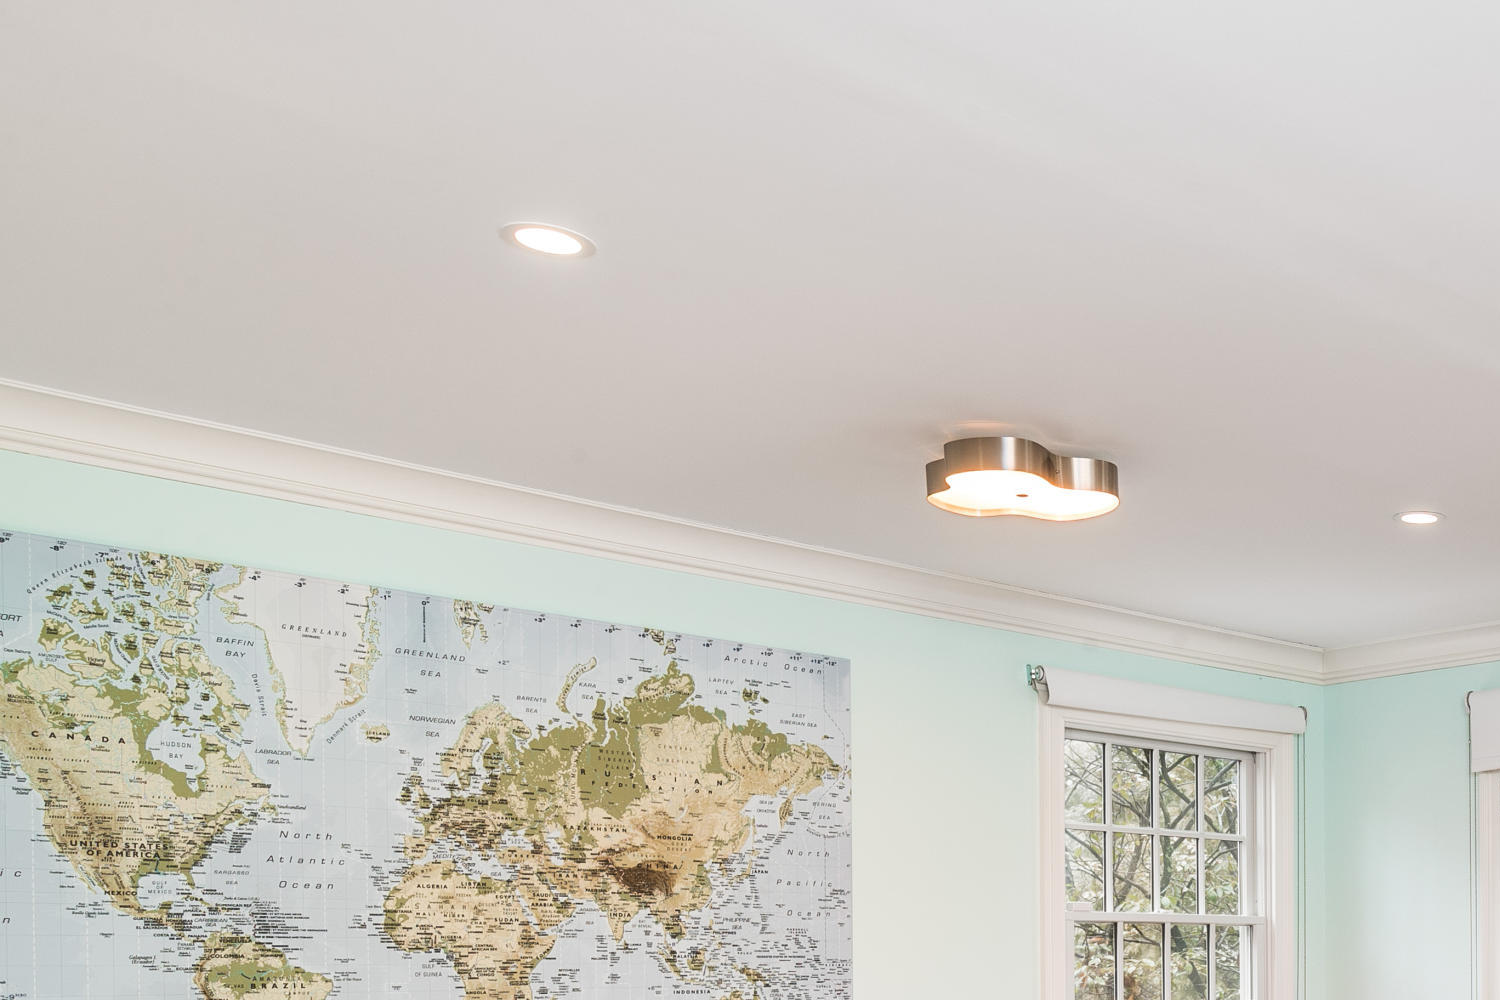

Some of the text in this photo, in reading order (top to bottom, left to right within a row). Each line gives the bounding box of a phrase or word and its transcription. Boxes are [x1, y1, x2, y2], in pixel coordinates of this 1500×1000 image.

[26, 577, 49, 595] Queen
[281, 623, 348, 639] GREENLAND
[216, 636, 255, 648] BAFFIN
[225, 650, 247, 659] BAY
[394, 647, 466, 663] GREENLAND
[723, 655, 823, 676] Arctic Ocean
[419, 669, 442, 679] SEA
[251, 673, 268, 718] Davis Strait
[516, 695, 547, 704] BARENTS
[525, 707, 539, 715] SEA
[408, 714, 457, 726] NORWEGIAN
[31, 730, 126, 745] CANADA
[425, 730, 441, 739] SEA
[160, 740, 192, 749] HUDSON
[254, 748, 292, 757] LABRADOR
[562, 824, 628, 834] KAZAKHSTAN
[278, 831, 334, 841] North
[69, 840, 169, 851] UNITED STATES
[106, 850, 162, 859] AMERICA
[787, 849, 831, 858] North
[266, 855, 346, 867] Atlantic
[278, 880, 335, 891] Ocean
[776, 878, 833, 888] Pacific
[786, 909, 831, 918] Ocean
[250, 982, 307, 990] BRAZIL
